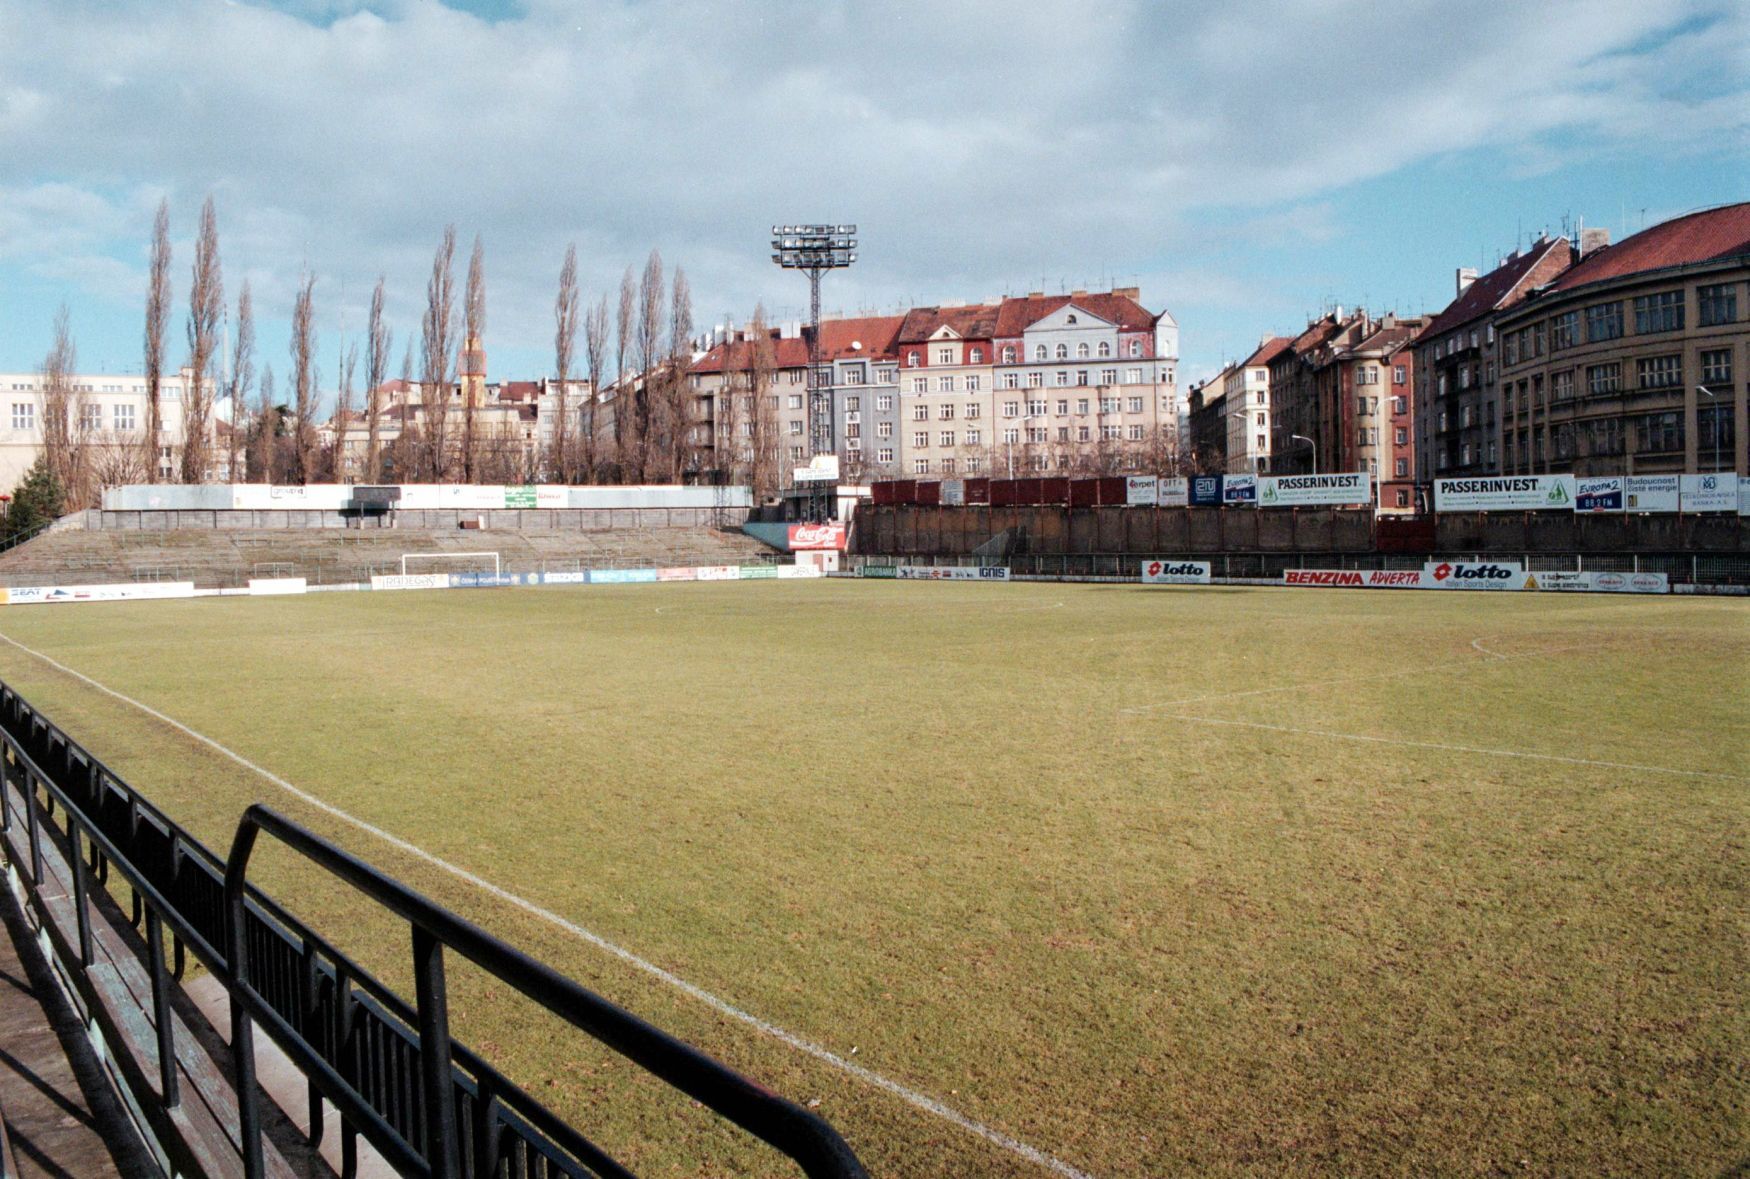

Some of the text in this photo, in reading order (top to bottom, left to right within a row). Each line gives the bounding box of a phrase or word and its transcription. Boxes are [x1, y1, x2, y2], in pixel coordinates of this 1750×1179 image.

[1278, 476, 1359, 489] PASSERINVEST
[1441, 479, 1538, 493] PASSERINVEST
[1612, 480, 1619, 490] 2
[1649, 485, 1677, 493] energie
[979, 568, 1005, 578] IGNIS
[1163, 563, 1204, 576] lotto
[1454, 565, 1512, 579] lotto
[1286, 572, 1420, 585] BENZINA ADVERTA
[1464, 580, 1484, 588] Sports
[1486, 580, 1507, 588] Design
[12, 588, 41, 596] SEAT
